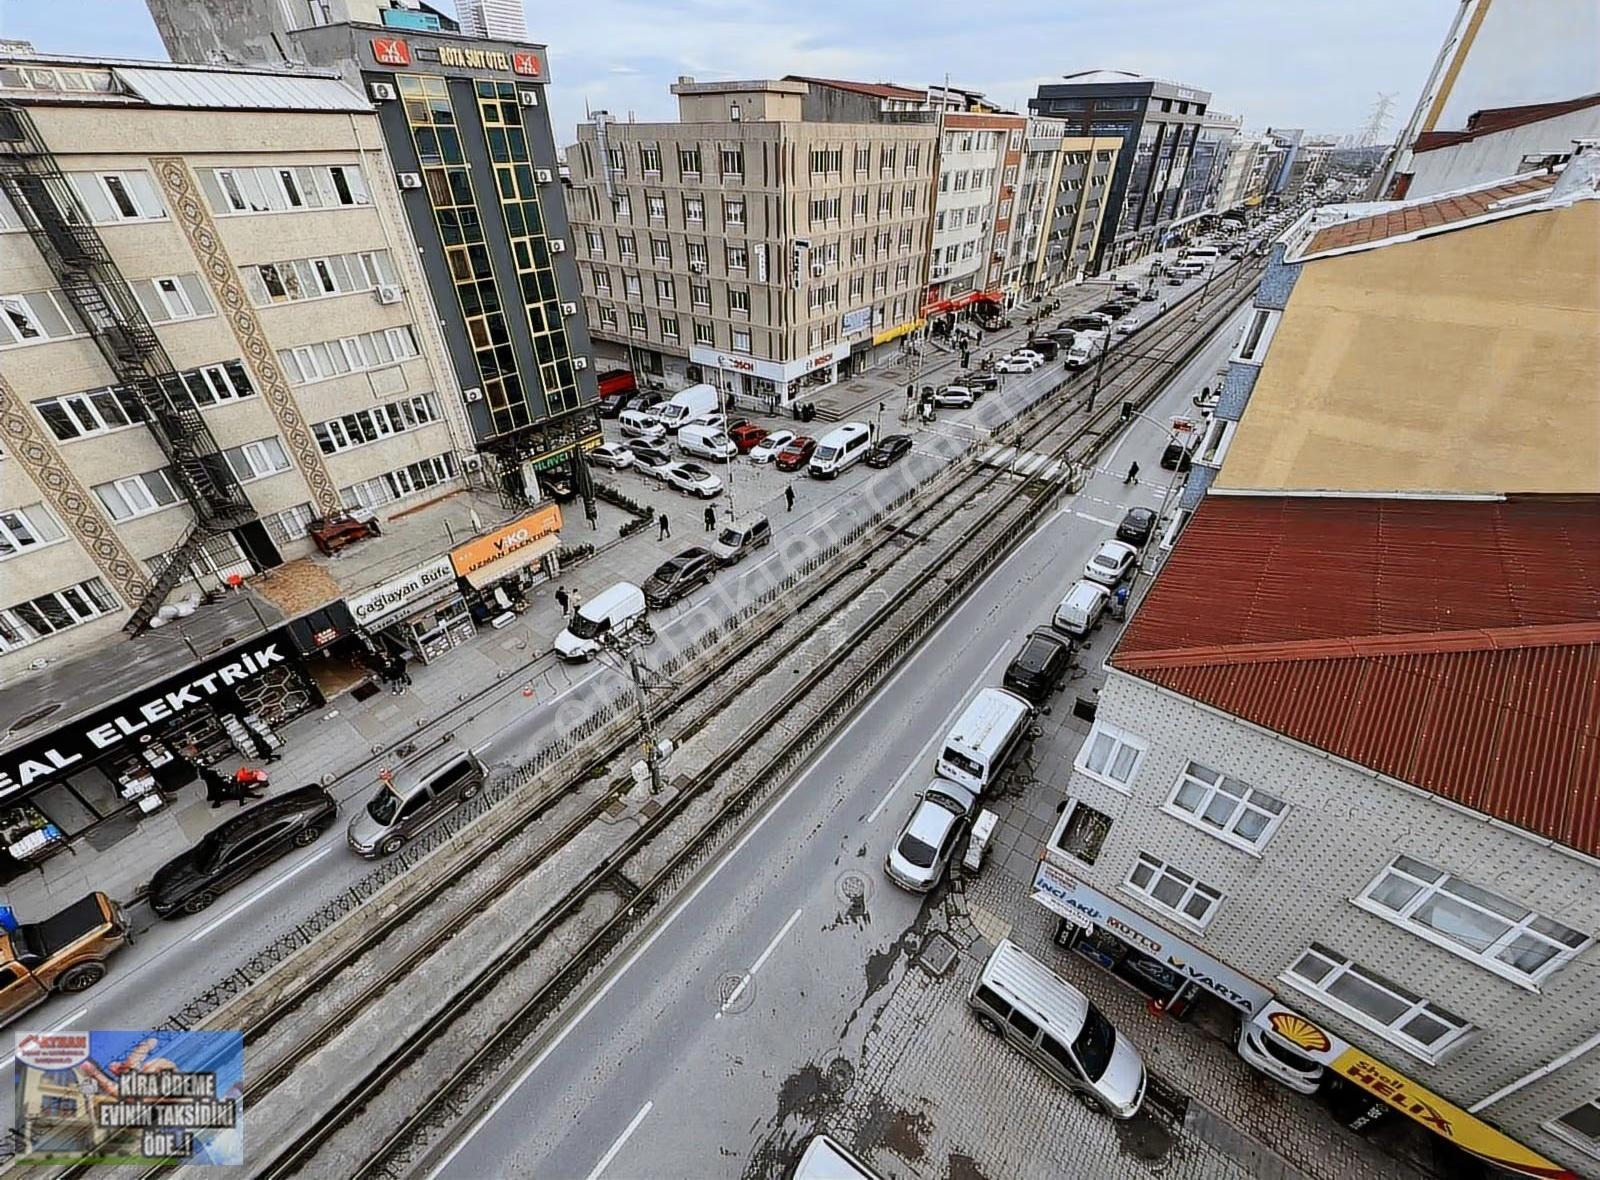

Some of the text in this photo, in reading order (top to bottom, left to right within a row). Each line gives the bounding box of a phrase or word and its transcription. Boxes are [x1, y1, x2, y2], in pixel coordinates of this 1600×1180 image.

[439, 46, 466, 67] ROTA
[485, 51, 509, 70] OTEL
[469, 551, 505, 572] UZMAN
[86, 643, 285, 749] ELEKTRİK
[1188, 965, 1253, 1012] VARTA
[1355, 1060, 1405, 1090] Shell
[1346, 1065, 1454, 1137] HELIX
